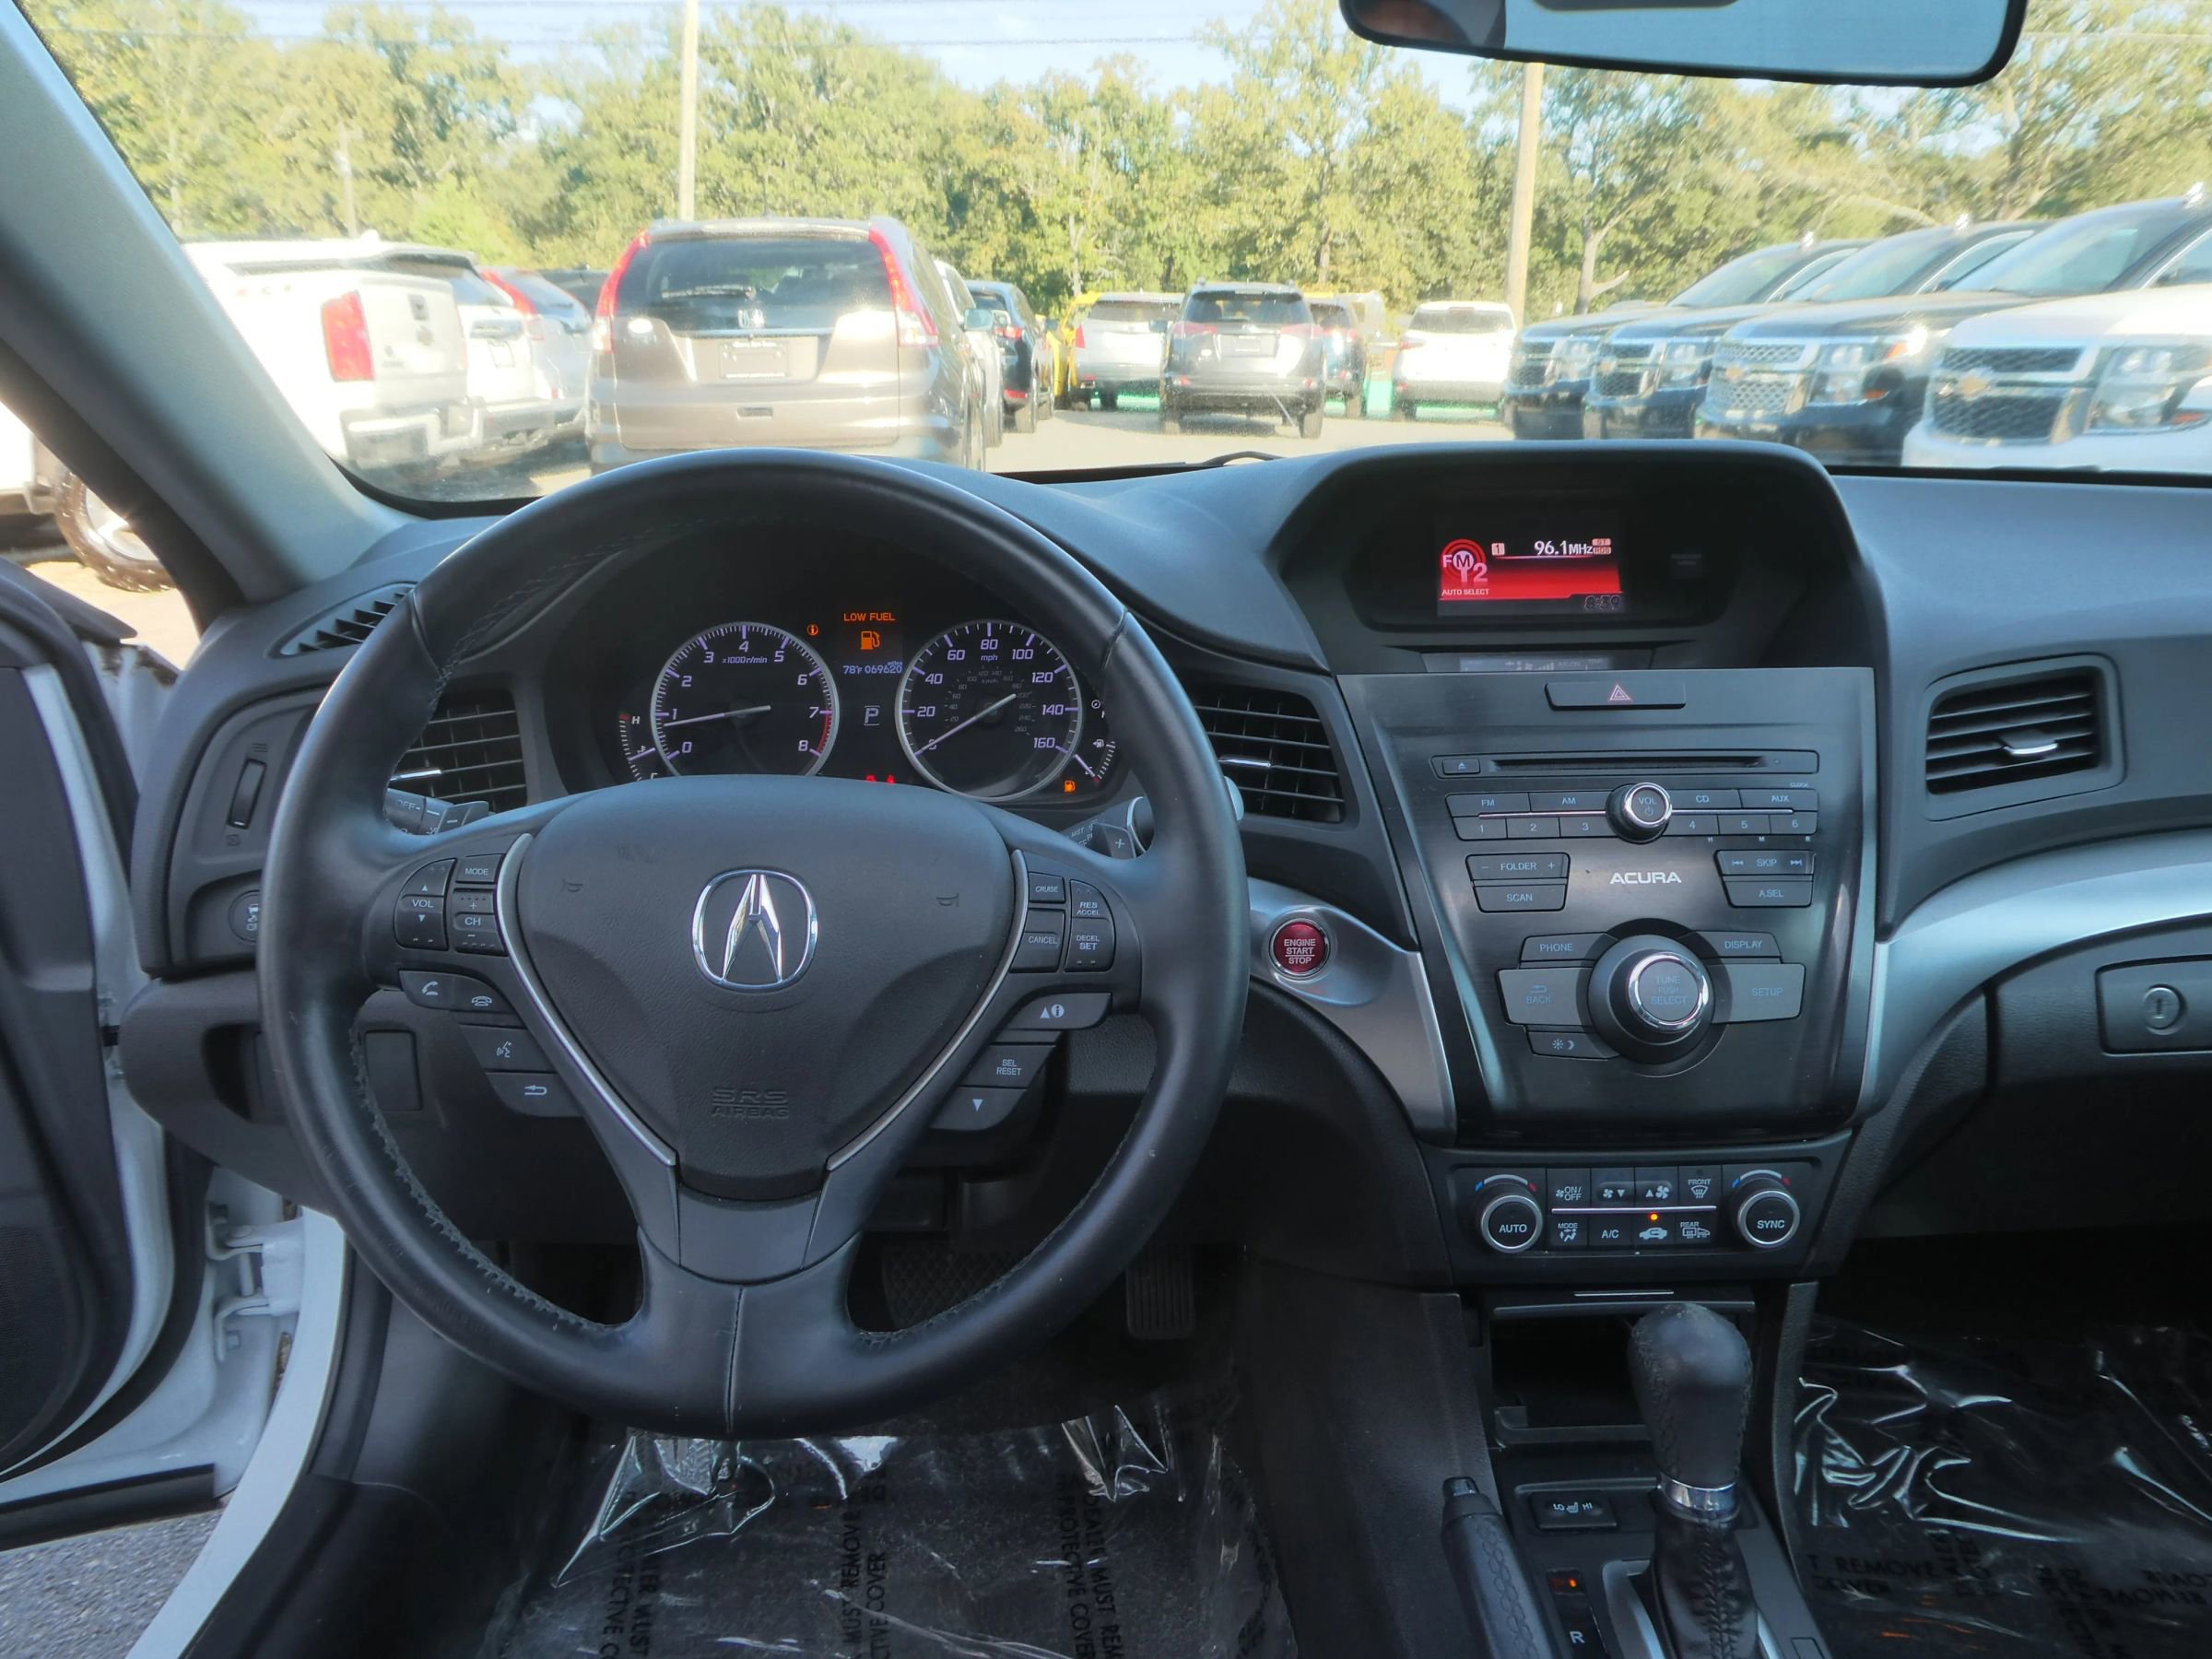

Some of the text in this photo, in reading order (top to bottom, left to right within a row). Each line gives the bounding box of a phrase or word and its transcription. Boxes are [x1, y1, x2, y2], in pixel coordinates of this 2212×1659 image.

[843, 612, 895, 621] LOW FUEL
[738, 641, 749, 653] 4
[980, 639, 998, 650] 80
[703, 652, 714, 663] 3
[773, 650, 784, 662] 5
[947, 650, 966, 661] 60
[981, 653, 998, 662] mph
[1012, 649, 1034, 660] 100
[865, 665, 902, 674] 069620
[681, 676, 692, 688] 2
[796, 674, 807, 686] 6
[924, 673, 943, 685] 40
[1031, 672, 1053, 683] 120
[672, 708, 677, 720] 1
[808, 706, 819, 718] 7
[917, 706, 935, 717] 20
[1041, 704, 1065, 715] 140
[631, 715, 641, 724] H
[865, 707, 879, 724] P
[681, 741, 692, 753] 0
[797, 740, 808, 751] 8
[1033, 737, 1055, 748] 160
[1481, 799, 1495, 807] FM
[1638, 796, 1658, 805] VOL
[1695, 794, 1710, 803] CD
[1529, 823, 1537, 831] 2
[1582, 822, 1589, 831] 3
[1688, 821, 1696, 830] 4
[1741, 820, 1748, 829] 5
[1792, 819, 1799, 828] 6
[1479, 825, 1485, 833] 1
[1500, 862, 1537, 871] FOLDER
[1756, 859, 1778, 867] SKIP
[465, 867, 489, 876] MODE
[1608, 871, 1682, 885] ACURA
[1035, 885, 1059, 893] CRUISE
[1506, 893, 1534, 901] SCAN
[412, 899, 434, 909] VOL
[1079, 901, 1099, 910] RES
[465, 917, 481, 926] CH
[1028, 935, 1058, 945] CANCEL
[1283, 938, 1316, 947] ENGINE
[1724, 940, 1763, 950] DISPLAY
[1078, 942, 1098, 951] SET
[1286, 947, 1314, 955] START
[1539, 943, 1574, 953] PHONE
[1288, 957, 1312, 965] STOP
[1751, 987, 1784, 997] SETUP
[1525, 995, 1552, 1005] BACK
[1002, 1059, 1018, 1067] SEL
[995, 1067, 1022, 1076] RESET
[1499, 1223, 1527, 1233] AUTO
[1757, 1218, 1785, 1230] SYNC
[1601, 1229, 1619, 1239] A/C
[839, 1509, 862, 1588] REMOVE
[865, 1552, 887, 1612] COVER
[1090, 1567, 1117, 1614] MUST
[1569, 1630, 1585, 1644] R
